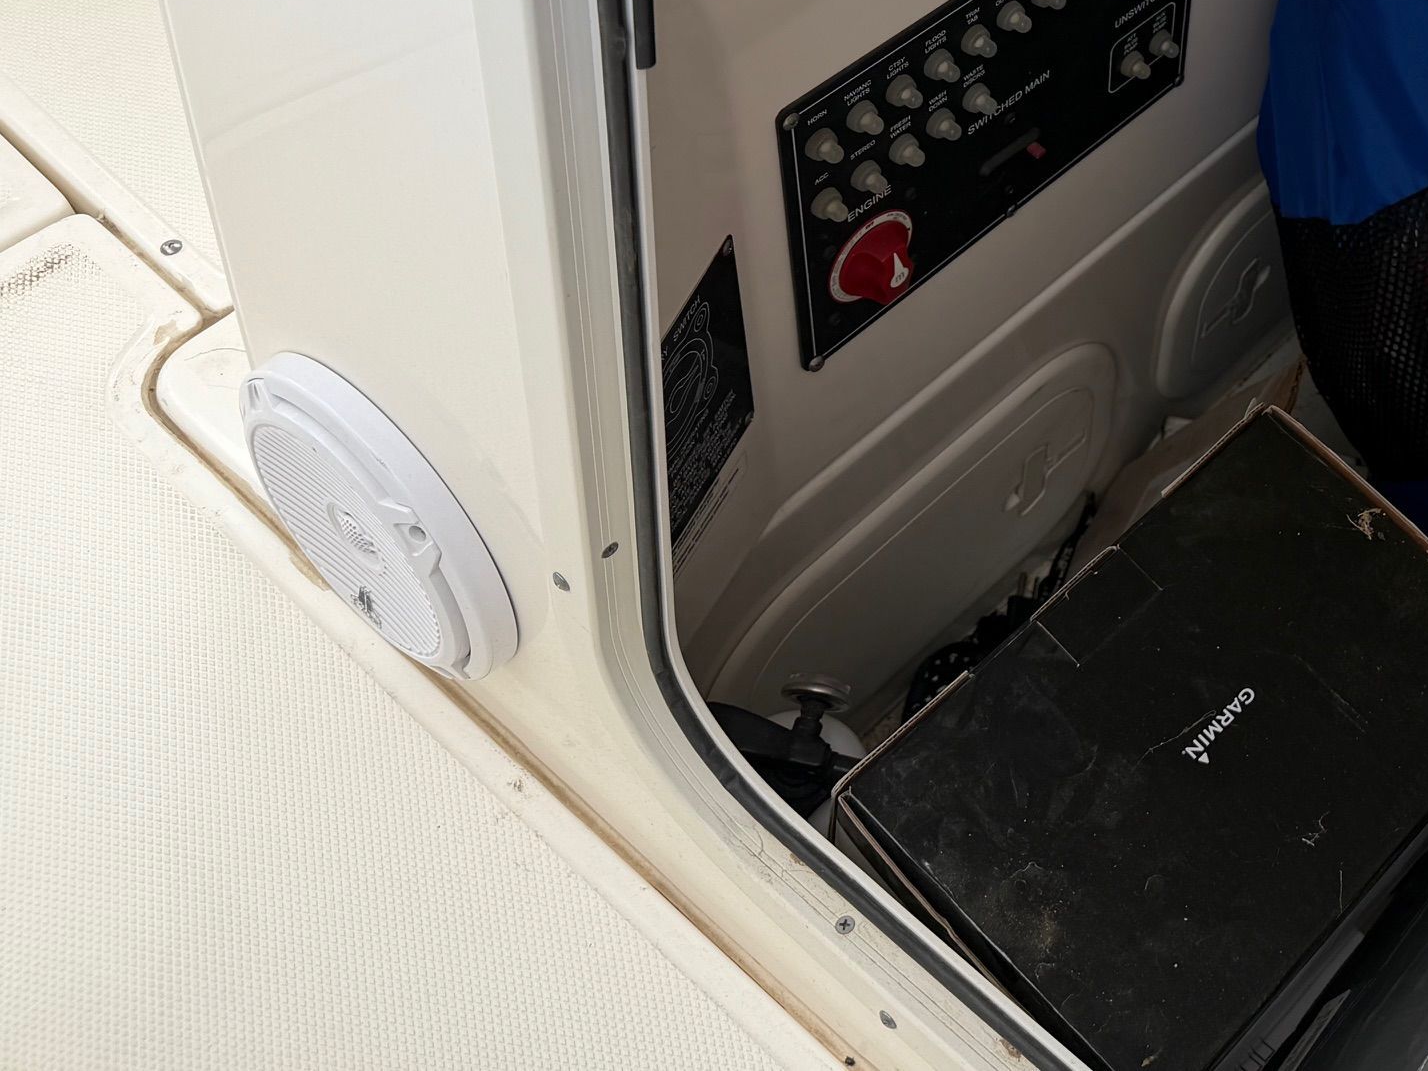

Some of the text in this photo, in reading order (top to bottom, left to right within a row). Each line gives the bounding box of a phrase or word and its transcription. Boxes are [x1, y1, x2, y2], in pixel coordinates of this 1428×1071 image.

[965, 7, 979, 20] TRIM
[924, 35, 946, 54] LIGHTS
[925, 29, 945, 47] FLOOD
[886, 61, 908, 80] LIGHTS
[888, 57, 904, 72] CTSY
[963, 64, 983, 81] WASTE
[846, 87, 870, 107] LIGHTS
[928, 90, 946, 106] WASH
[928, 95, 947, 112] DOWN
[968, 69, 1050, 135] SWITCHED MAIN
[807, 109, 827, 126] HORN
[890, 115, 910, 133] FRESH
[890, 121, 911, 139] WATER
[850, 140, 875, 160] STEREO
[814, 172, 828, 185] ACC
[847, 184, 892, 223] ENGINE
[672, 295, 702, 341] SWITCH
[1184, 687, 1255, 760] GARMIN
